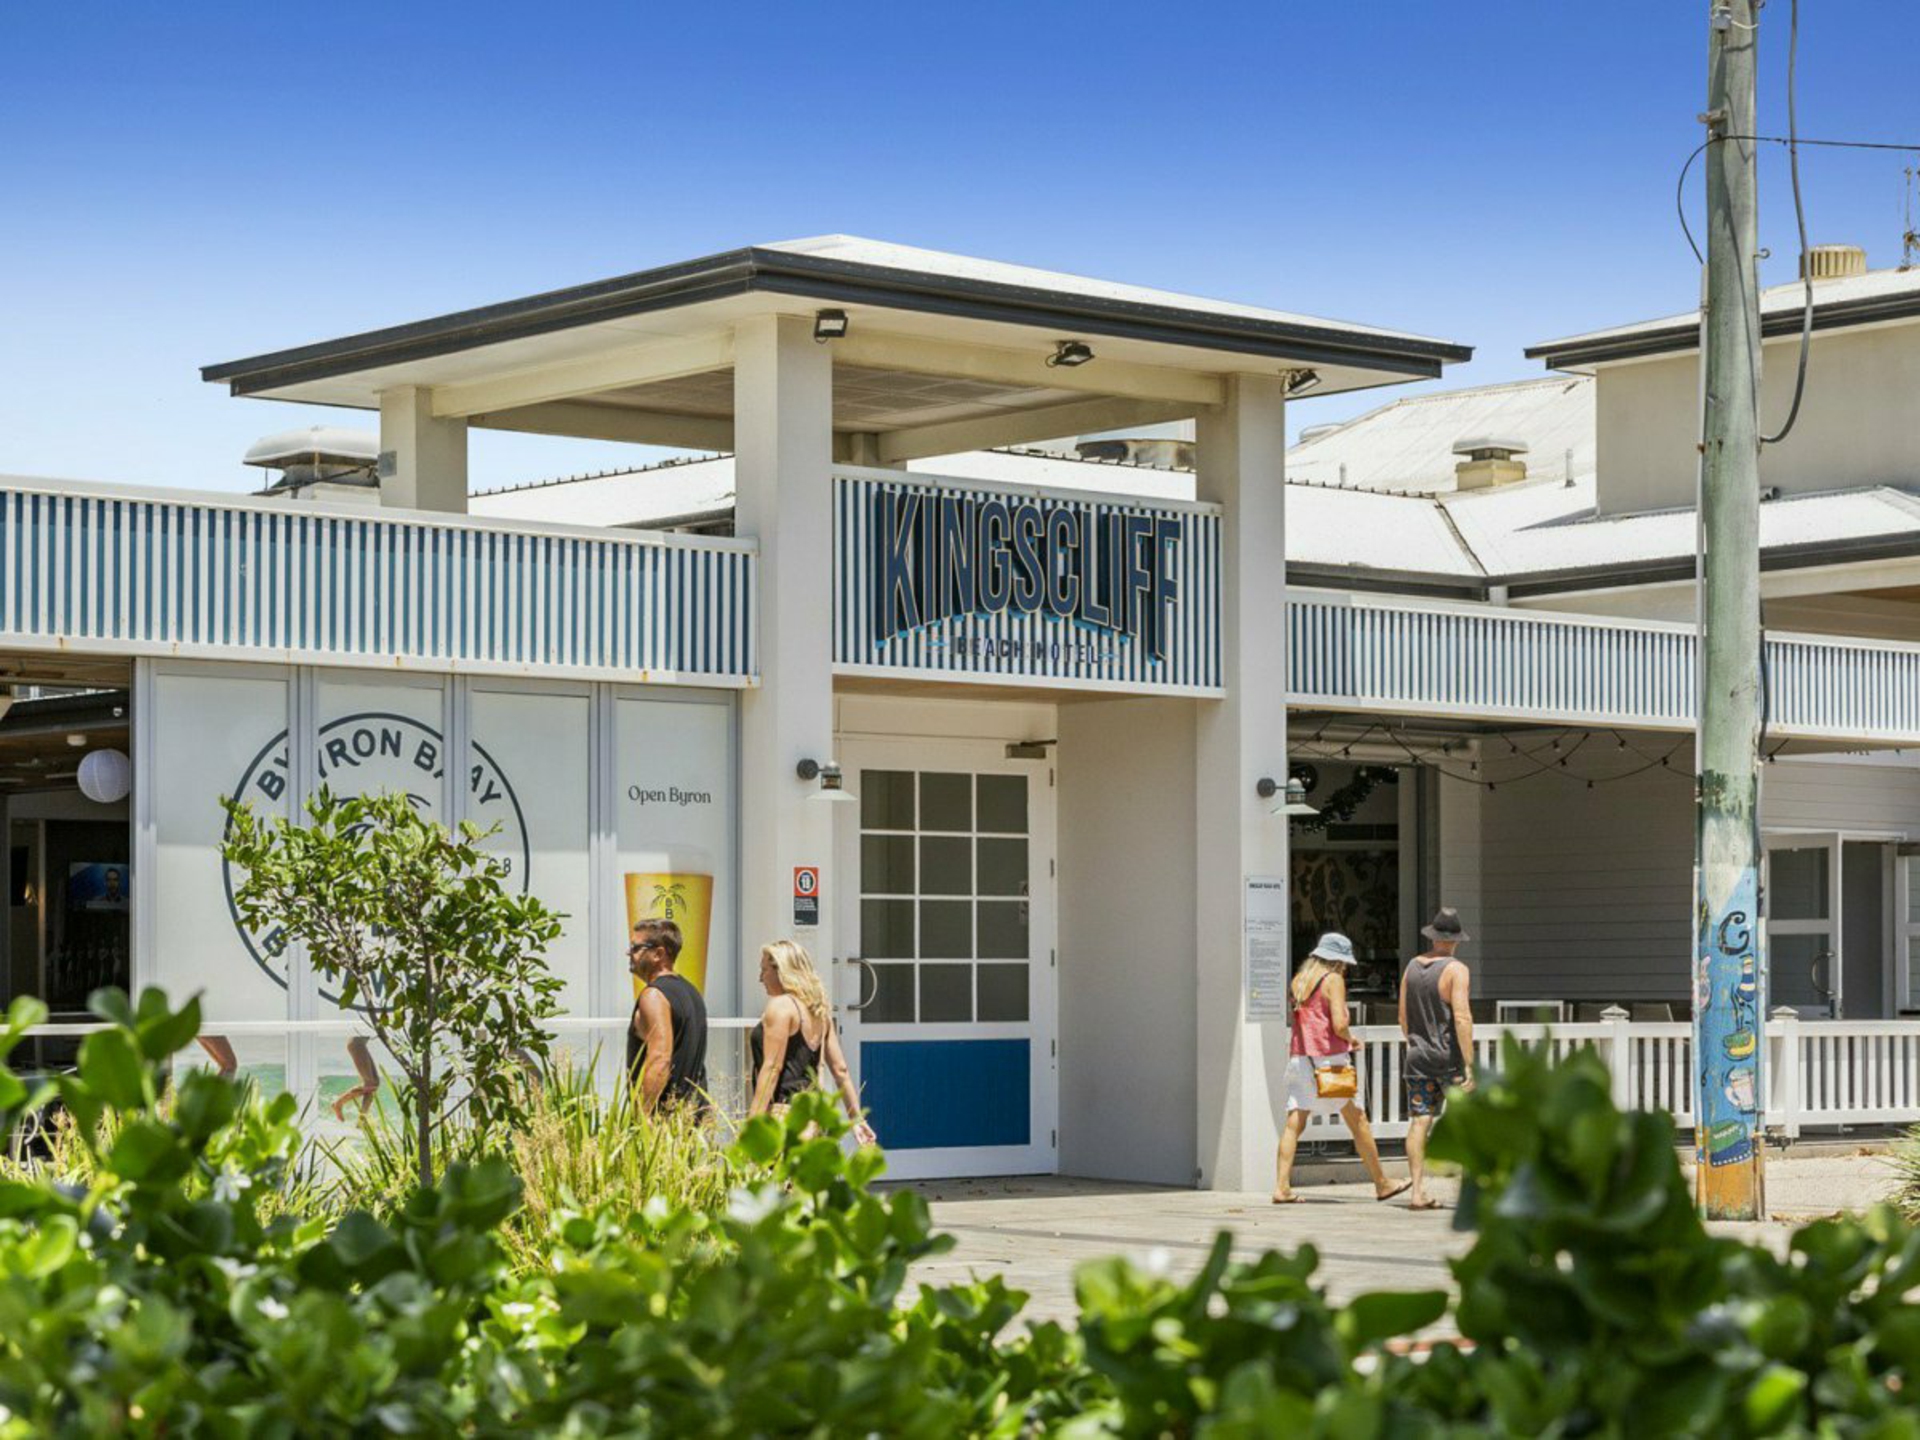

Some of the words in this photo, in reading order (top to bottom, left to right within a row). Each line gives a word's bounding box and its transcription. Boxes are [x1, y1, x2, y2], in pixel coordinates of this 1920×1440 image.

[876, 489, 1182, 662] KINGSCLIFF
[957, 637, 1024, 658] BEACH
[1036, 641, 1098, 665] HOTEL
[628, 785, 666, 805] Open
[669, 786, 711, 806] Byron
